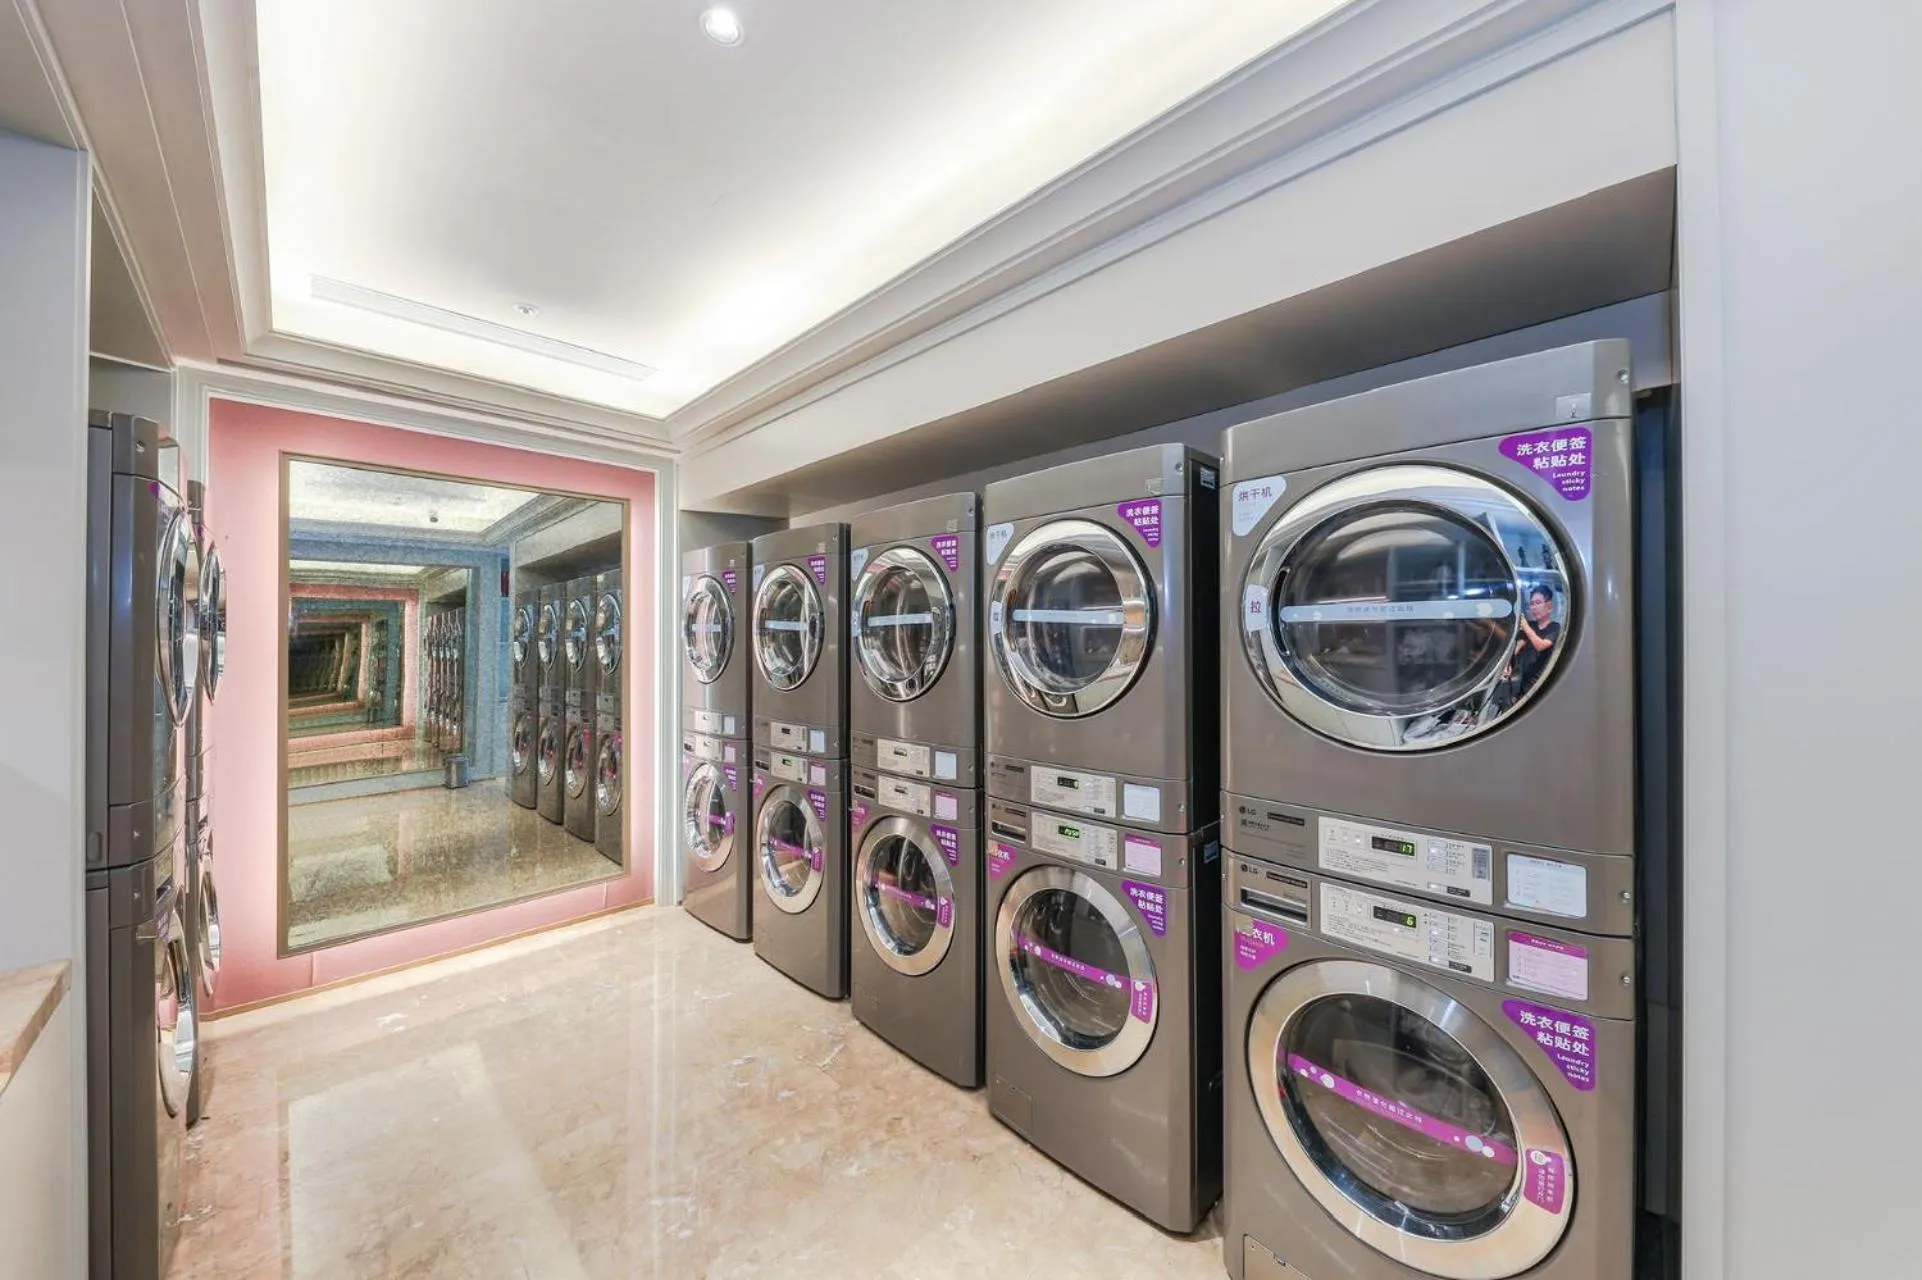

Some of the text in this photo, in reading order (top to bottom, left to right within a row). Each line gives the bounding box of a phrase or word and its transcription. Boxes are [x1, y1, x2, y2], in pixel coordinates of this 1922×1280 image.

[1517, 436, 1587, 456] 洗衣便签
[1533, 452, 1586, 469] 粘贴处
[1552, 471, 1586, 479] Laundry
[1239, 486, 1273, 502] 烘干机
[1520, 1009, 1590, 1041] 洗衣便签
[1536, 1031, 1590, 1057] 粘贴处
[1557, 1053, 1590, 1069] Laundry
